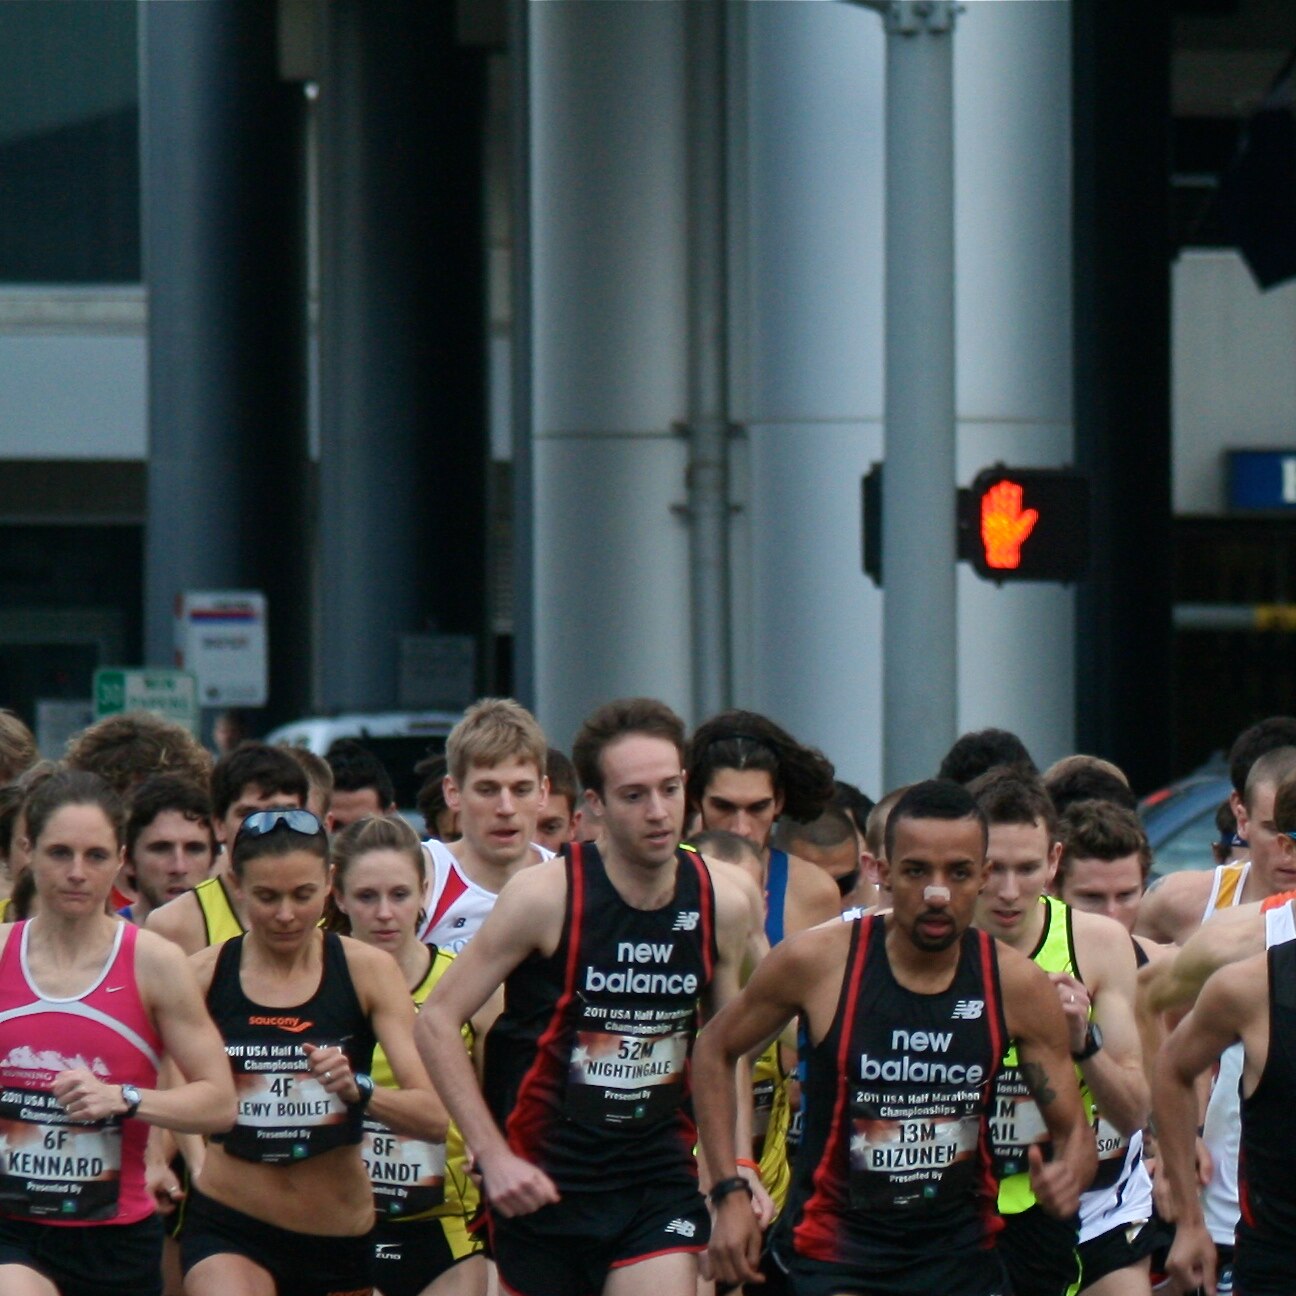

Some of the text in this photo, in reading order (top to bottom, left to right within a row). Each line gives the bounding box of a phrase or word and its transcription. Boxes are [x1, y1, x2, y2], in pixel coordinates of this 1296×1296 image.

[617, 942, 674, 964] new
[585, 966, 698, 994] balance
[583, 1007, 607, 1018] 2011
[609, 1009, 631, 1020] USA
[634, 1010, 654, 1021] Half
[246, 1045, 268, 1057] USA
[271, 1045, 291, 1057] Half
[617, 1040, 654, 1061] 52M
[891, 1029, 953, 1053] new
[587, 1060, 672, 1080] NIGHTINGALE
[860, 1053, 984, 1084] balance
[270, 1078, 294, 1098] 4F
[856, 1091, 980, 1105] 2011 USA Half Marathon
[24, 1095, 45, 1107] USA
[277, 1100, 331, 1116] BOULET
[880, 1105, 956, 1118] Championships
[44, 1130, 68, 1150] 6F
[257, 1130, 312, 1139] Presented By
[899, 1124, 936, 1144] 13M
[990, 1122, 1018, 1141] AIL
[373, 1137, 396, 1157] 8F
[1097, 1137, 1121, 1152] SON
[8, 1151, 103, 1178] KENNARD
[872, 1142, 958, 1168] BIZUNEH
[26, 1181, 69, 1193] Presented
[889, 1171, 943, 1184] Presented By
